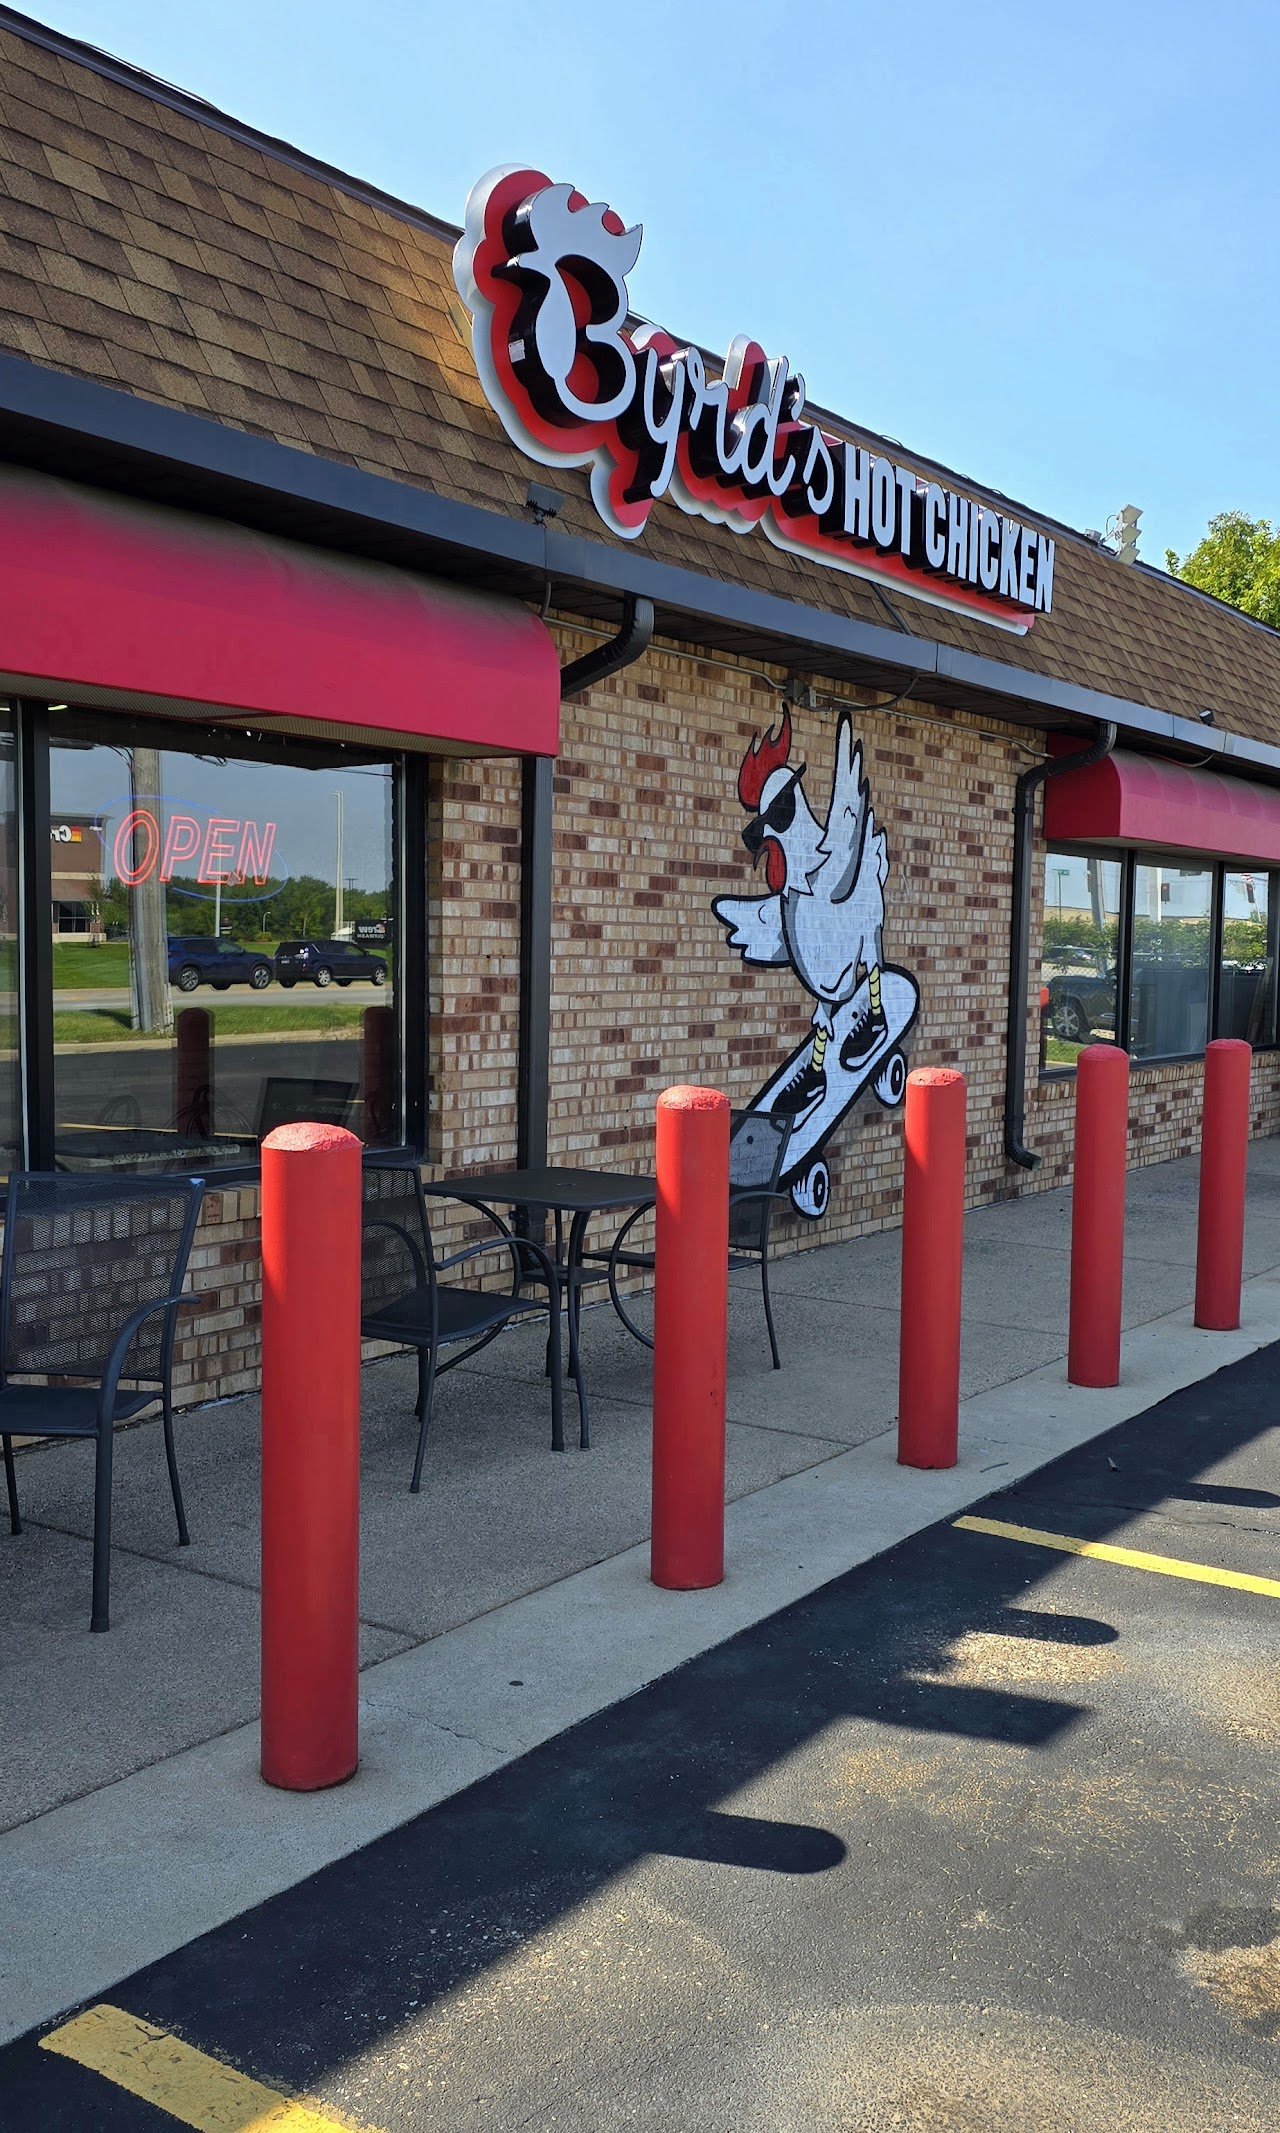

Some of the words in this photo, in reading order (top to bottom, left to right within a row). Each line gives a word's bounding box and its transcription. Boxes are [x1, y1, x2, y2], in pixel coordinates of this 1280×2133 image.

[512, 182, 834, 515] Byrd's
[843, 441, 916, 555] HOT
[925, 482, 1056, 614] CHICKEN
[113, 809, 277, 886] OPEN
